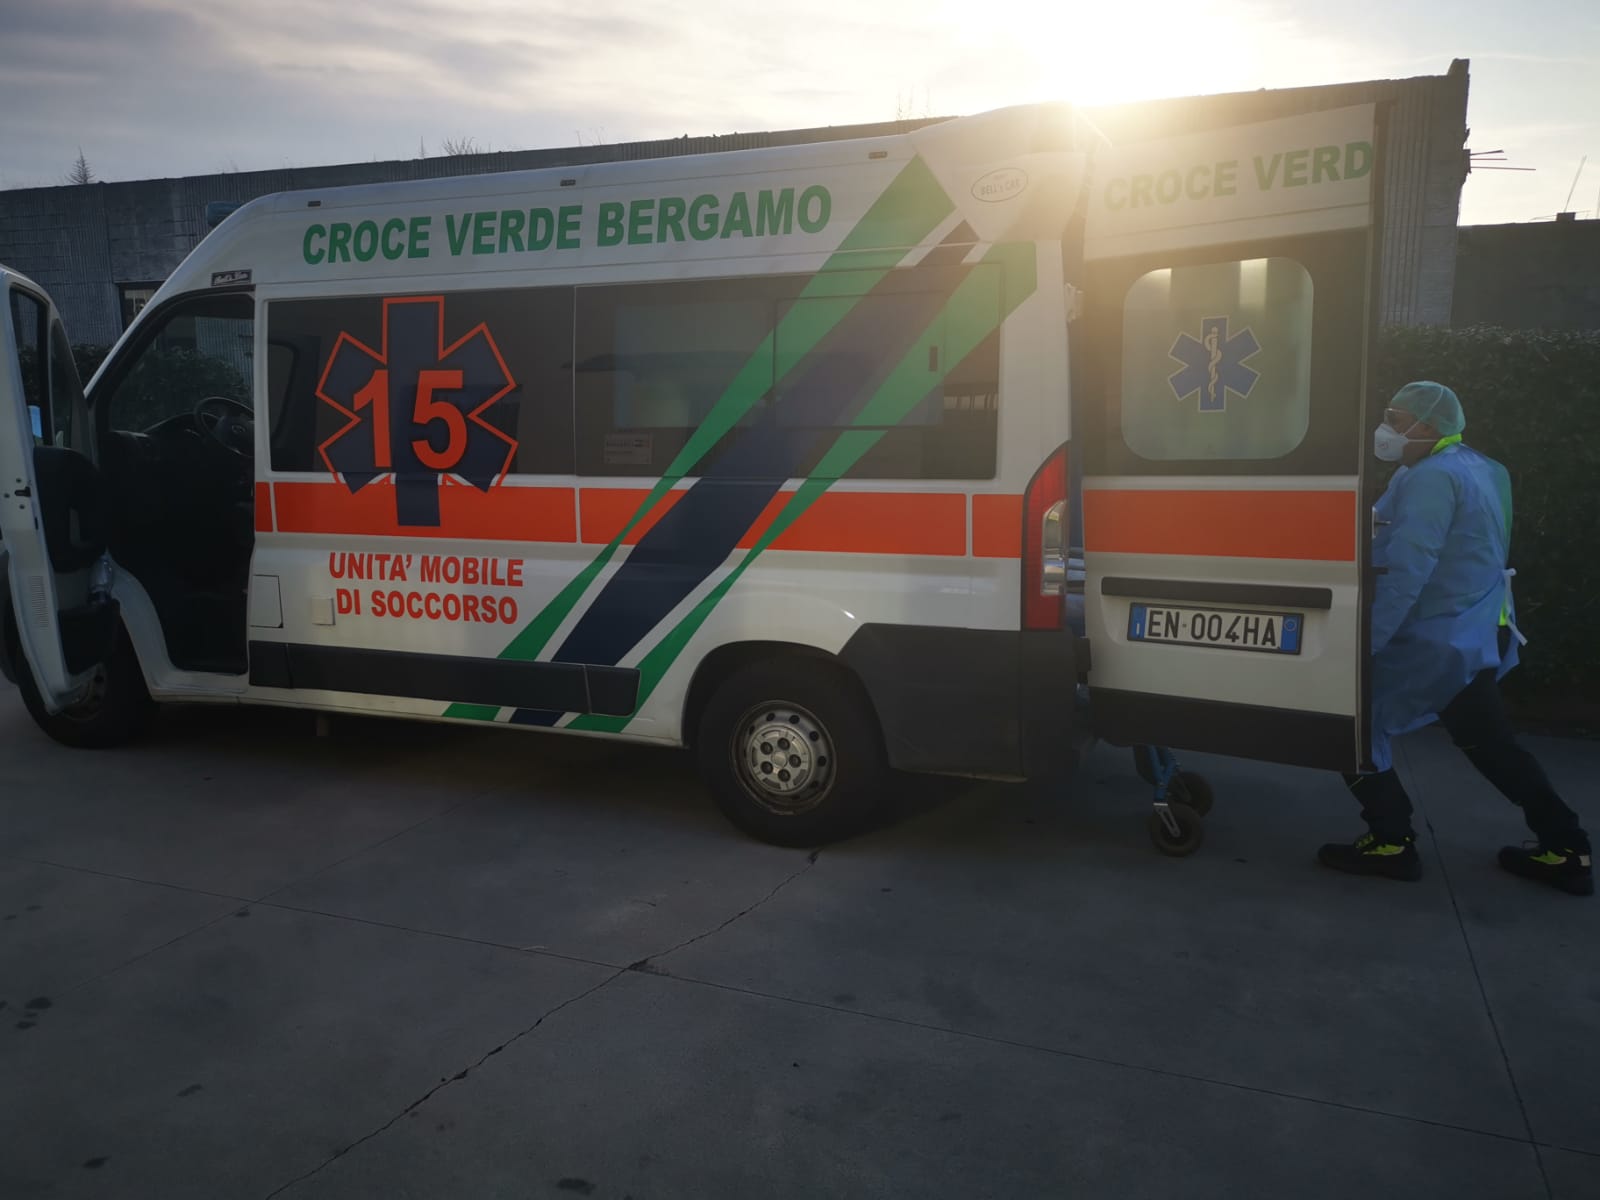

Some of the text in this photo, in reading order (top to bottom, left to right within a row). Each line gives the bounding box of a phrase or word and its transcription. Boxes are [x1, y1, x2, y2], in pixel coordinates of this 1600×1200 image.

[1102, 141, 1373, 211] CROCE VERD
[302, 185, 832, 265] CROCE VERDE BERGAMO
[353, 369, 468, 470] 15
[329, 552, 524, 587] UNITA' MOBILE
[336, 588, 518, 625] DI SOCCORSO
